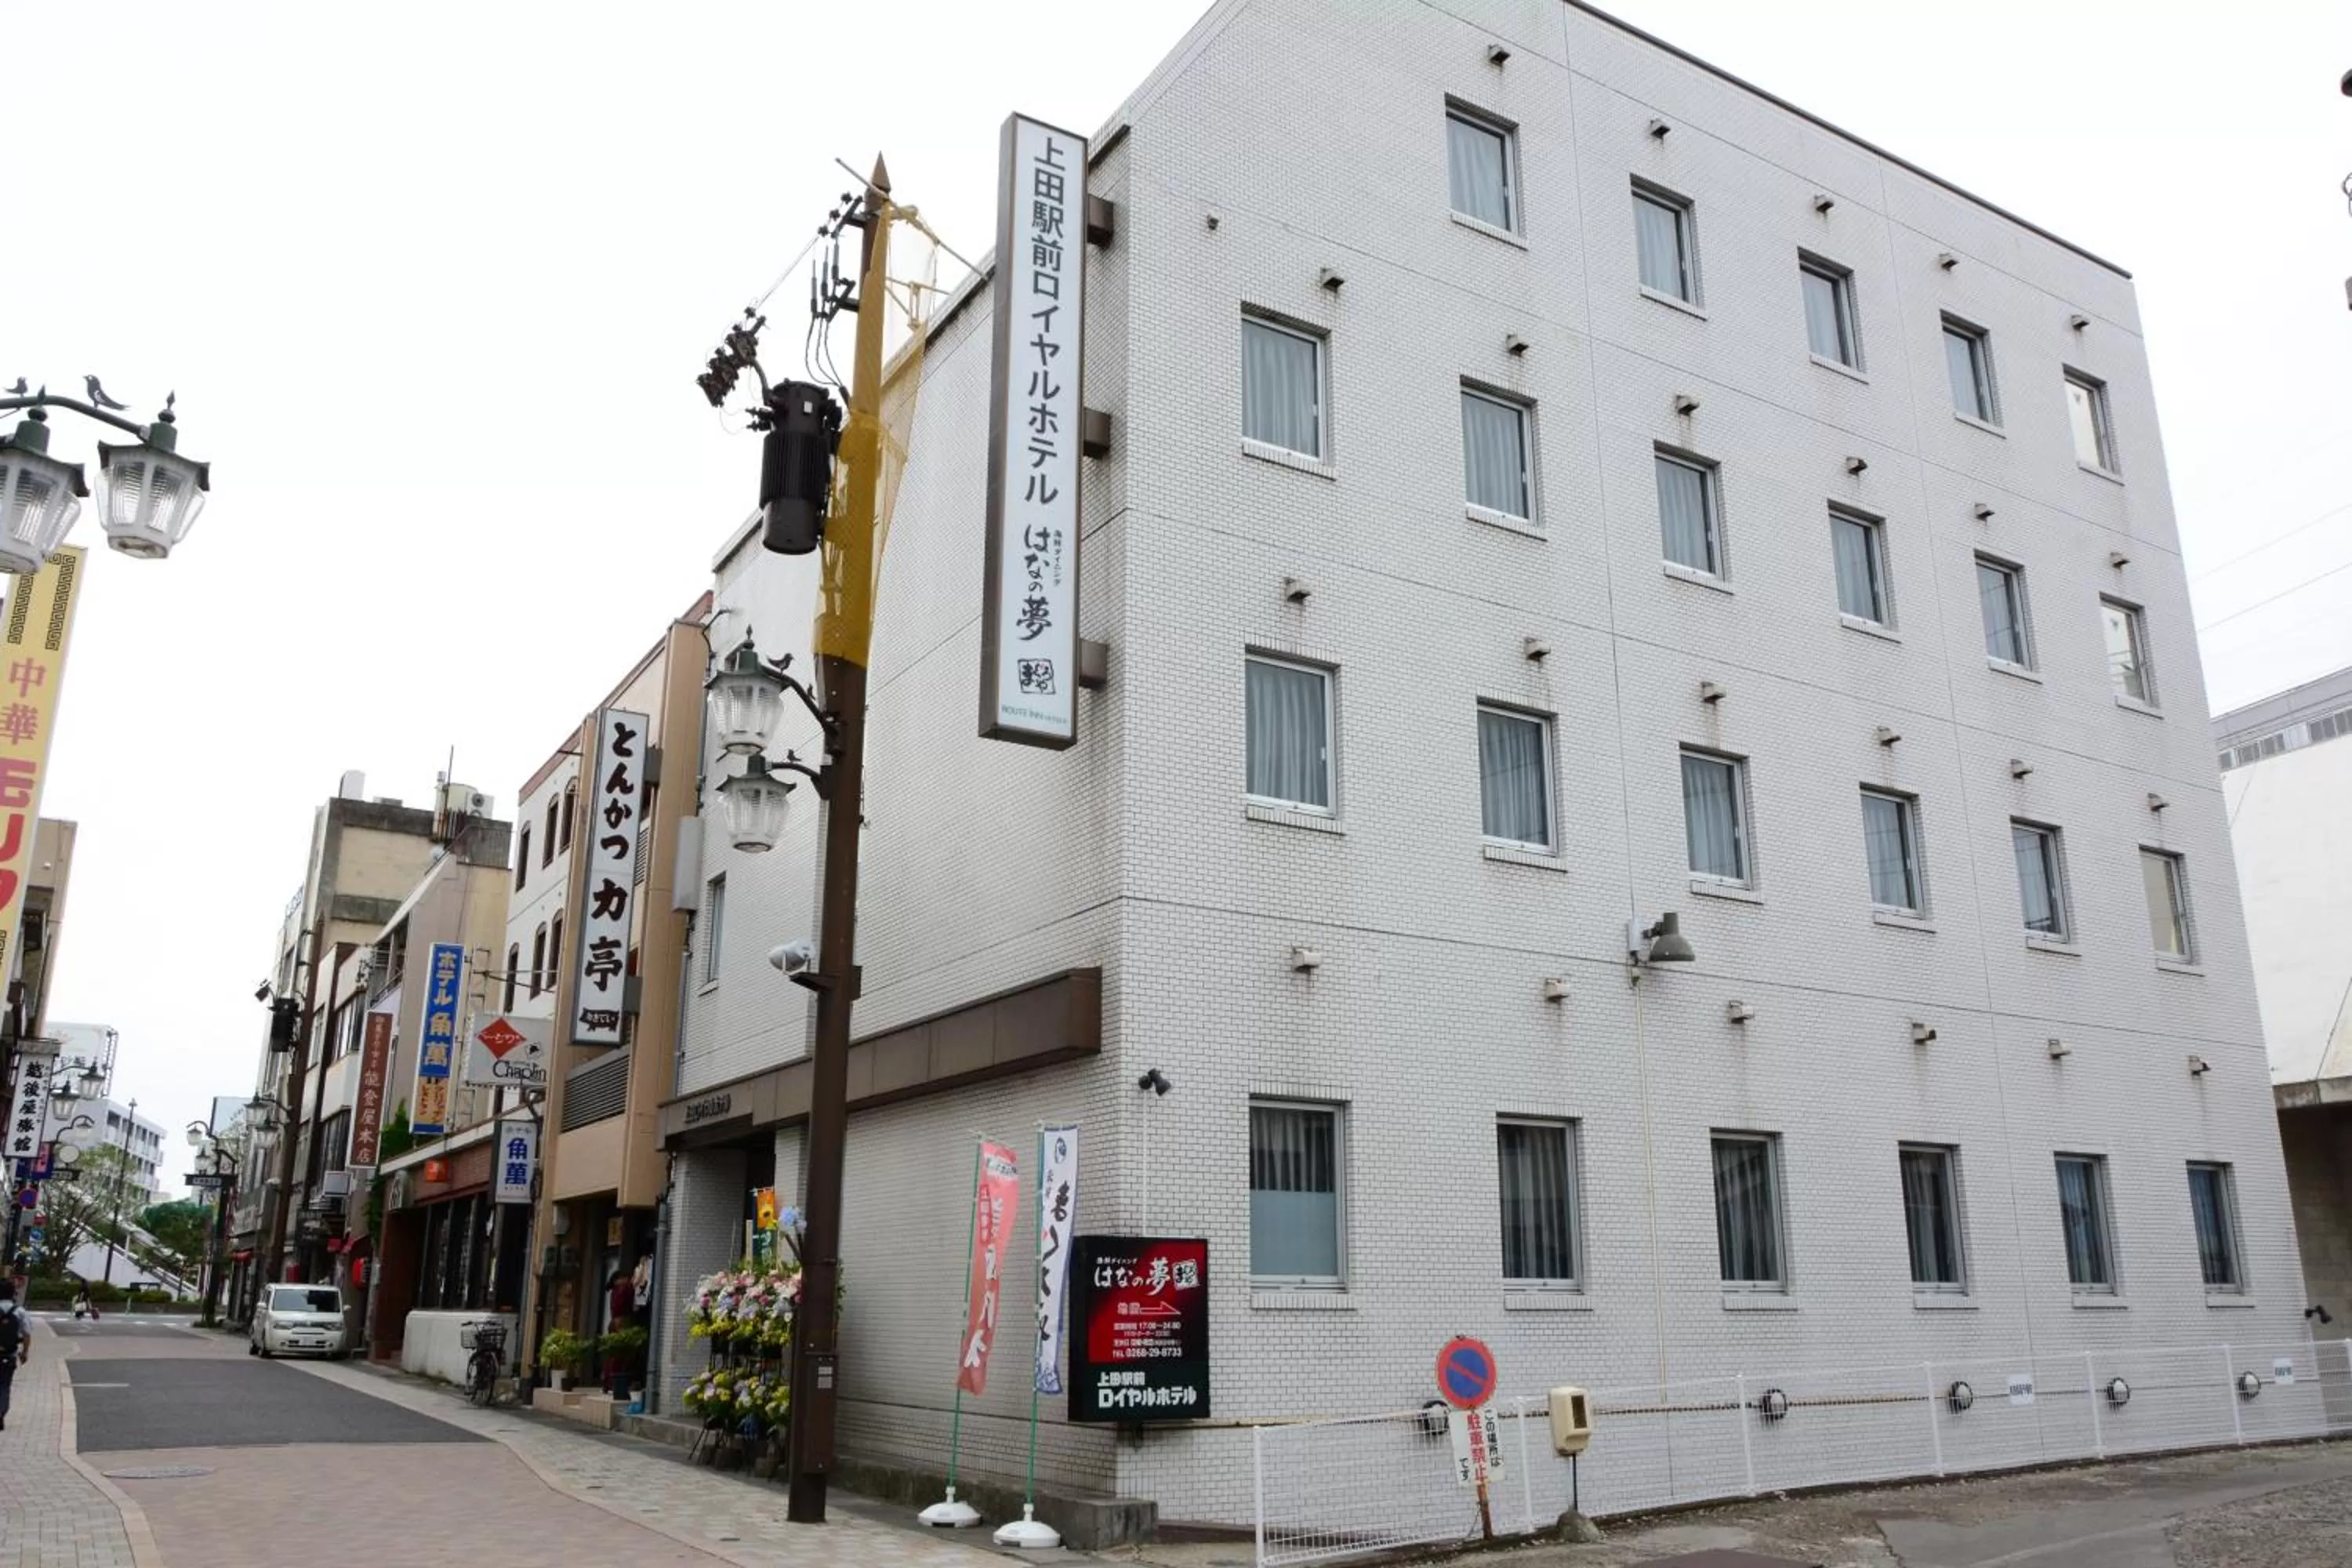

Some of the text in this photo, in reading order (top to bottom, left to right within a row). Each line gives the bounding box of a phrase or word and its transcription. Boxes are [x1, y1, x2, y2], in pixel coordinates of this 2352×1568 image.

[1025, 136, 1065, 506] 上田駅前ロイヤルホテル
[1016, 524, 1052, 641] はなの夢
[584, 721, 637, 993] とんかつ 力亭
[13, 1060, 45, 1152] 越後屋旅館
[492, 1059, 547, 1086] Chaplin
[1094, 1256, 1171, 1296] はなの夢
[1098, 1372, 1145, 1386] 上田駅前
[1098, 1385, 1197, 1408] ロイヤルホテル
[1467, 1413, 1487, 1482] 駐車禁止
